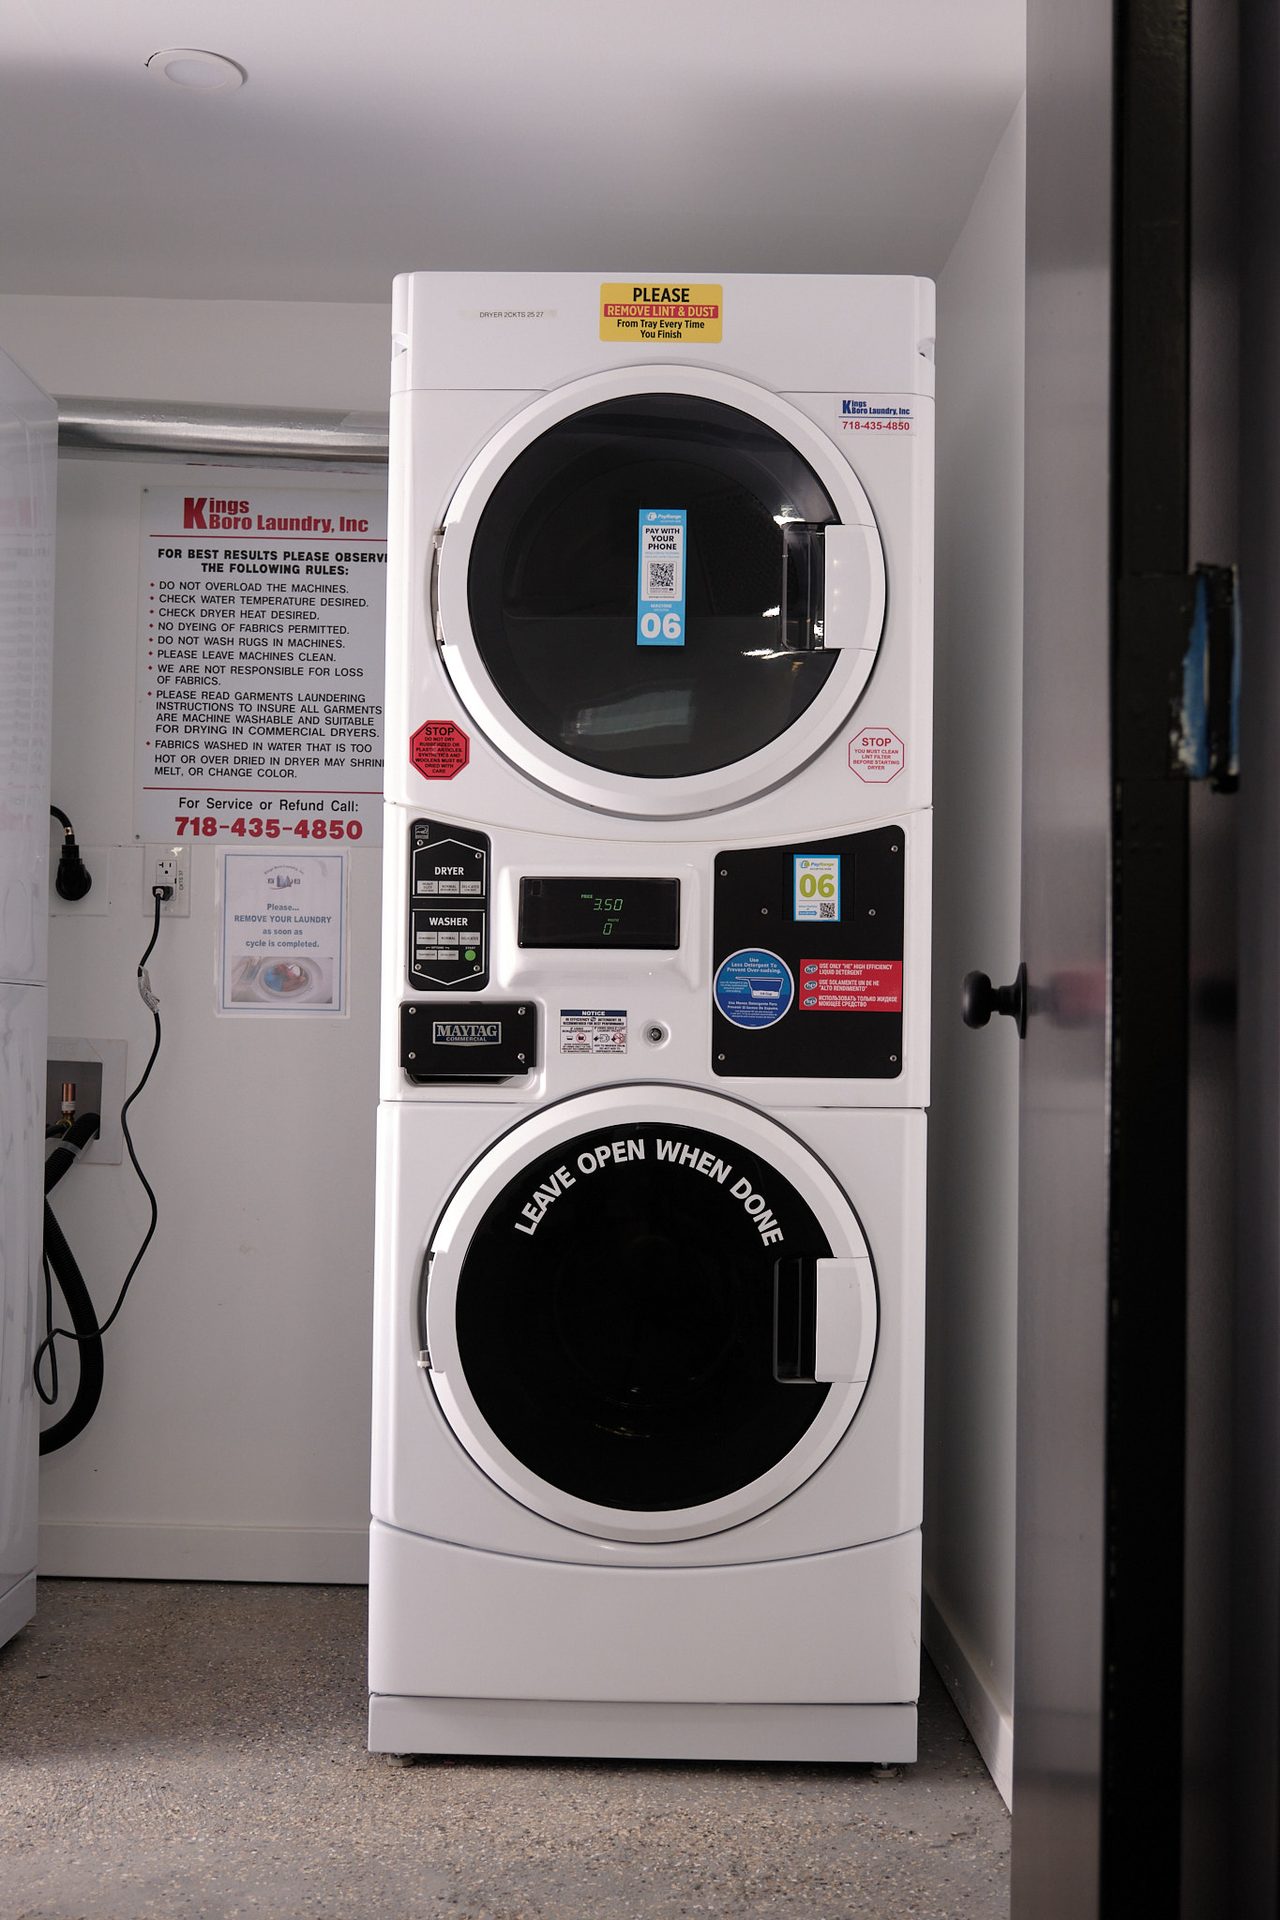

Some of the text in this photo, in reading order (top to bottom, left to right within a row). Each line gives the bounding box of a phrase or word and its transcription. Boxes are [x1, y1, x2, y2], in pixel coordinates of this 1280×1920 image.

[633, 288, 689, 302] PLEASE
[607, 306, 715, 317] REMOVE LINT & DUST
[617, 319, 705, 331] From Tray Every Time
[640, 329, 682, 339] You Finish
[843, 400, 867, 414] Kings
[851, 407, 868, 415] Boro
[869, 407, 898, 415] Laundry,
[843, 422, 909, 430] 718-435-4850
[183, 497, 250, 529] Kings
[209, 513, 368, 533] Boro Laundry, Inc
[158, 549, 182, 559] FOR
[188, 549, 219, 559] BEST
[224, 550, 278, 561] RESULTS
[283, 551, 329, 562] PLEASE
[201, 563, 349, 575] THE FOLLOWING RULES:
[159, 581, 349, 594] DO NOT OVERLOAD THE MACHINES.
[159, 594, 369, 607] CHECK WATER TEMPERATURE DESIRED.
[159, 608, 319, 620] CHECK DRYER HEAT DESIRED.
[158, 622, 349, 635] NO DYEING OF FABRICS PERMITTED.
[641, 613, 681, 639] 06
[158, 636, 345, 649] DO NOT WASH RUGS IN MACHINES.
[157, 649, 336, 662] PLEASE LEAVE MACHINES CLEAN.
[157, 664, 364, 677] WE ARE NOT RESPONSIBLE FOR LOSS
[157, 676, 221, 686] OF FABRICS.
[156, 690, 366, 703] PLEASE READ GARMENTS LAUNDERING
[156, 701, 382, 715] INSTRUCTIONS TO INSURE ALL GARMENTS
[156, 713, 374, 726] ARE MACHINE WASHABLE AND SUITABLE
[156, 724, 379, 738] FOR DRYING IN COMMERCIAL DRYERS.
[426, 727, 454, 735] STOP
[155, 740, 372, 753] FABRICS WASHED IN WATER THAT IS TOO
[862, 738, 891, 746] STOP
[155, 754, 346, 767] HOT OR OVER DRIED IN DRYER MAY
[154, 766, 297, 778] MELT, OR CHANGE COLOR.
[179, 797, 358, 812] For Service or Refund Call:
[175, 816, 363, 840] 718-435-4850
[435, 867, 464, 875] DRYER
[800, 874, 834, 897] 06
[594, 899, 623, 911] 3.50
[234, 915, 332, 924] REMOVE YOUR LAUNDRY
[429, 917, 468, 926] WASHER
[603, 923, 612, 935] 0
[246, 939, 267, 948] cycle
[277, 940, 320, 949] completed.
[437, 1025, 497, 1036] MAYTAG
[515, 1139, 784, 1246] LEAVE OPEN WHEN DONE
